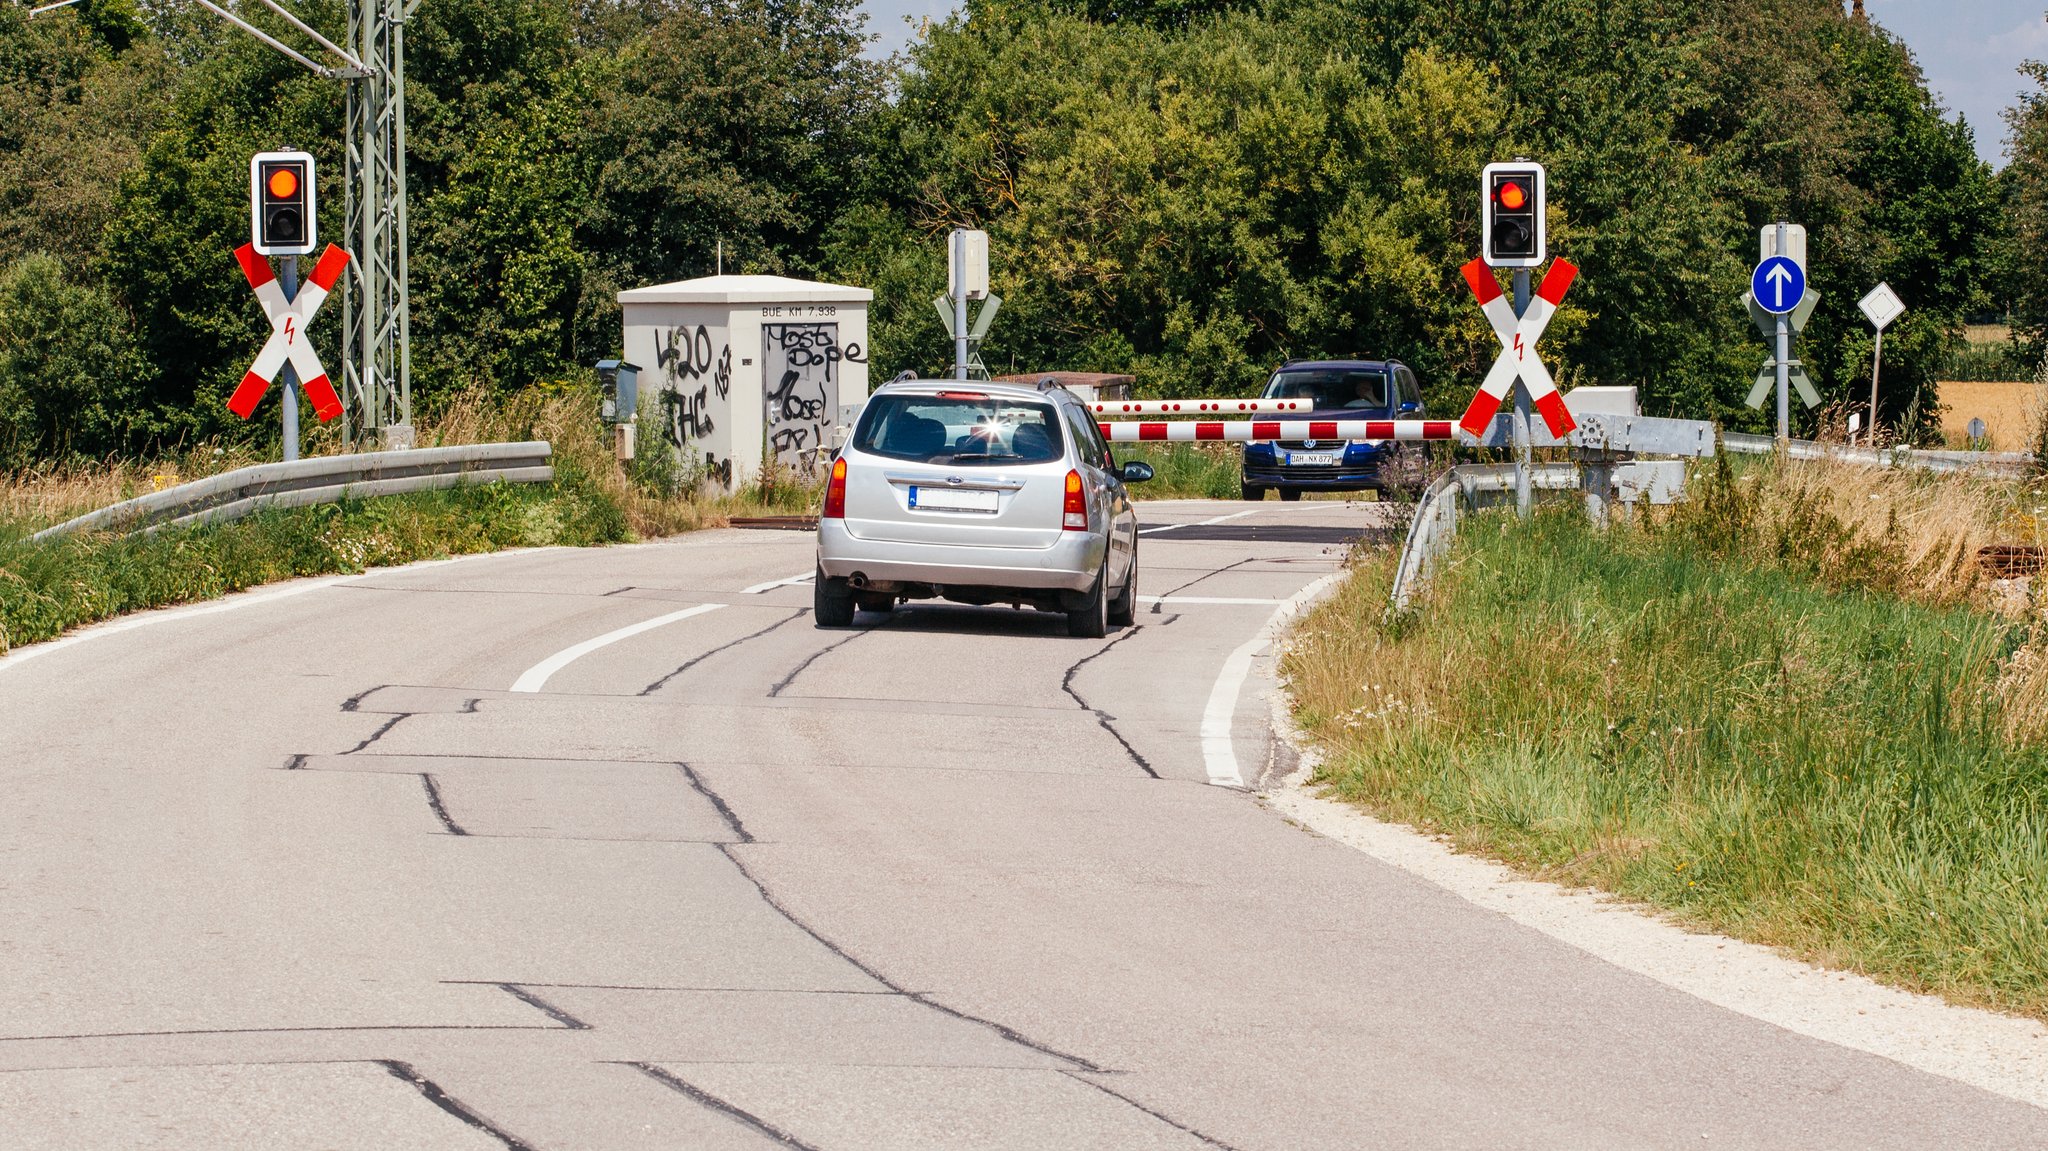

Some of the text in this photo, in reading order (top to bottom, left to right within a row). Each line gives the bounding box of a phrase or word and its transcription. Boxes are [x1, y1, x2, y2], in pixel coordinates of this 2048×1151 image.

[762, 307, 782, 317] BUE
[788, 307, 802, 316] KM
[655, 324, 712, 380] 420
[788, 343, 868, 382] Dope
